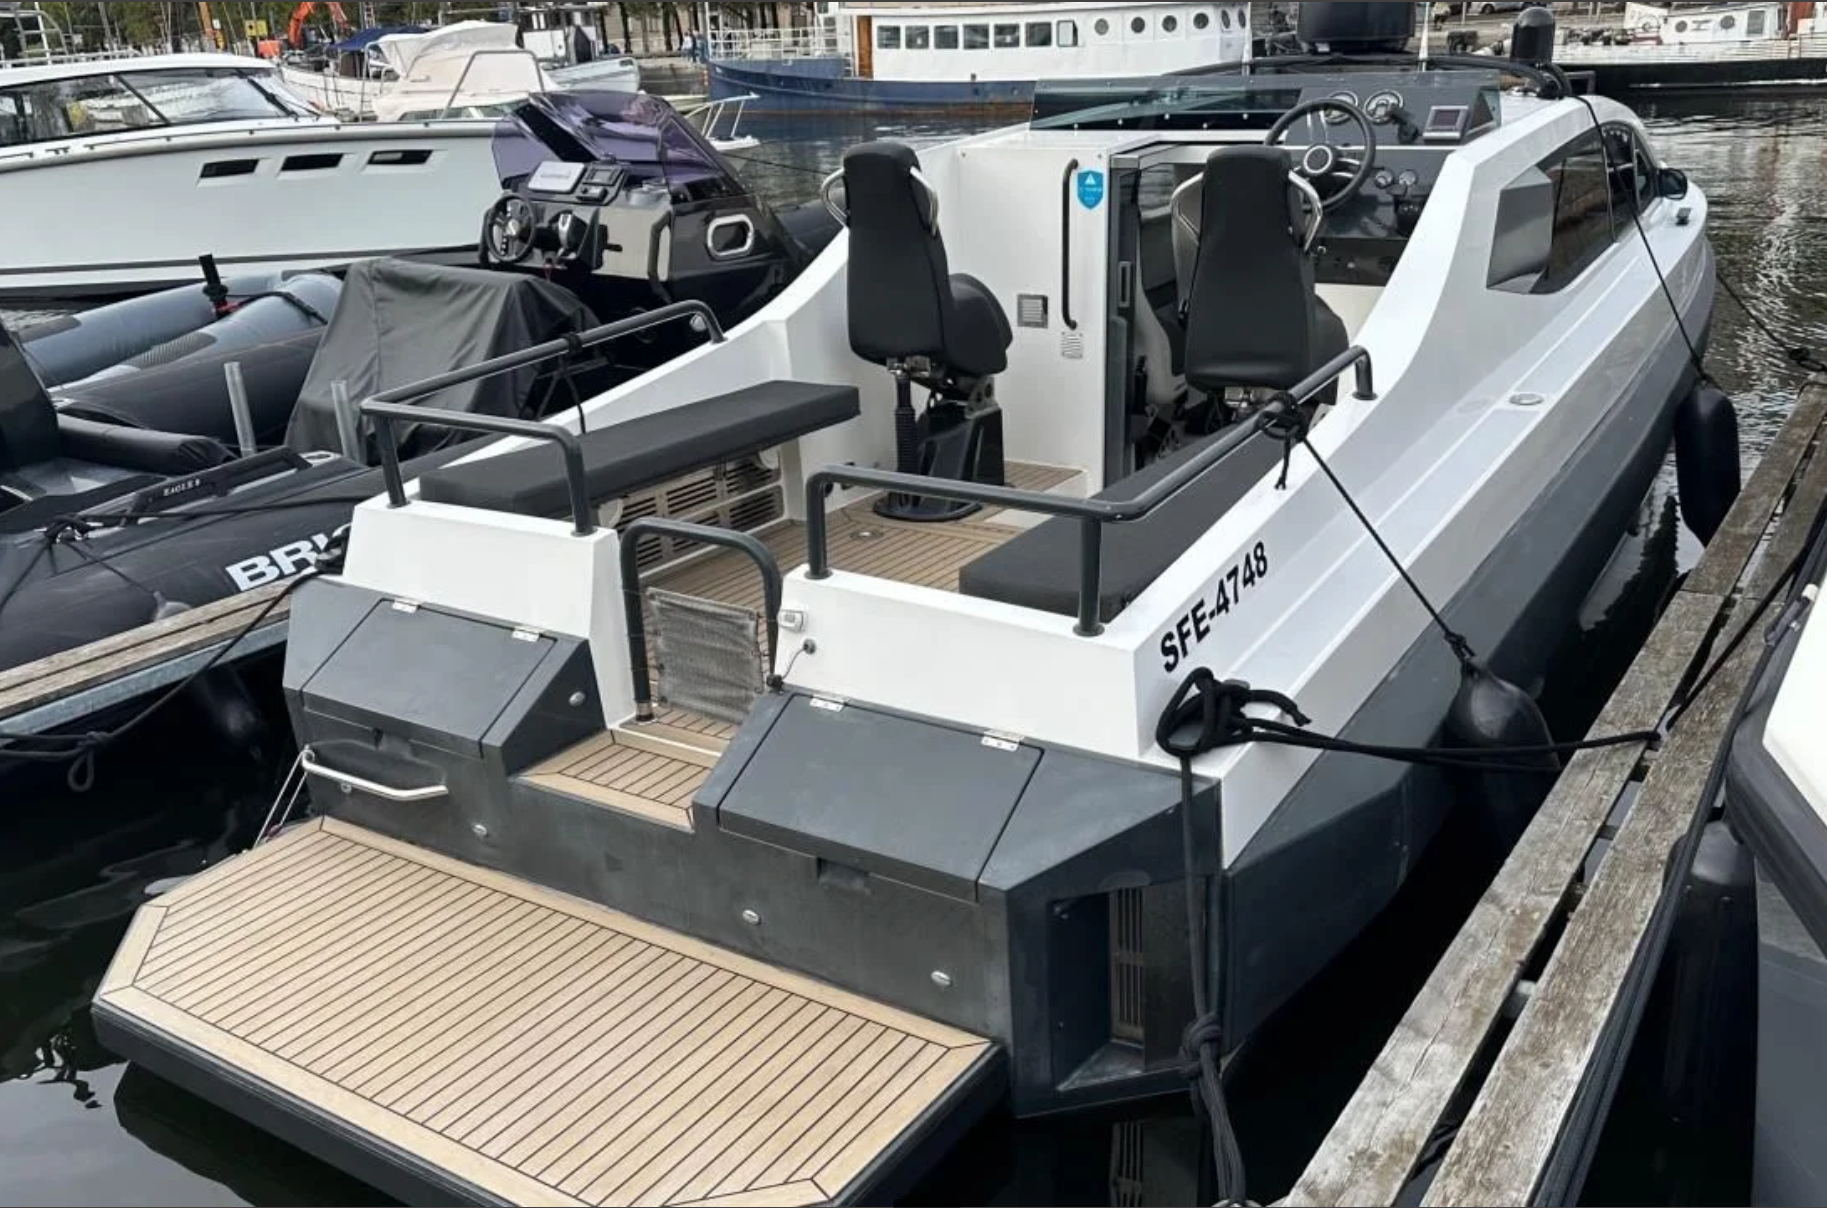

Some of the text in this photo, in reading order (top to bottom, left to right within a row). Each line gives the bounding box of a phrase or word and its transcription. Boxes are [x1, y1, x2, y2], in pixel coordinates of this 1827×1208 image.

[163, 480, 195, 497] EAGLE
[225, 523, 352, 592] BR
[1160, 540, 1268, 673] SFE-4748
